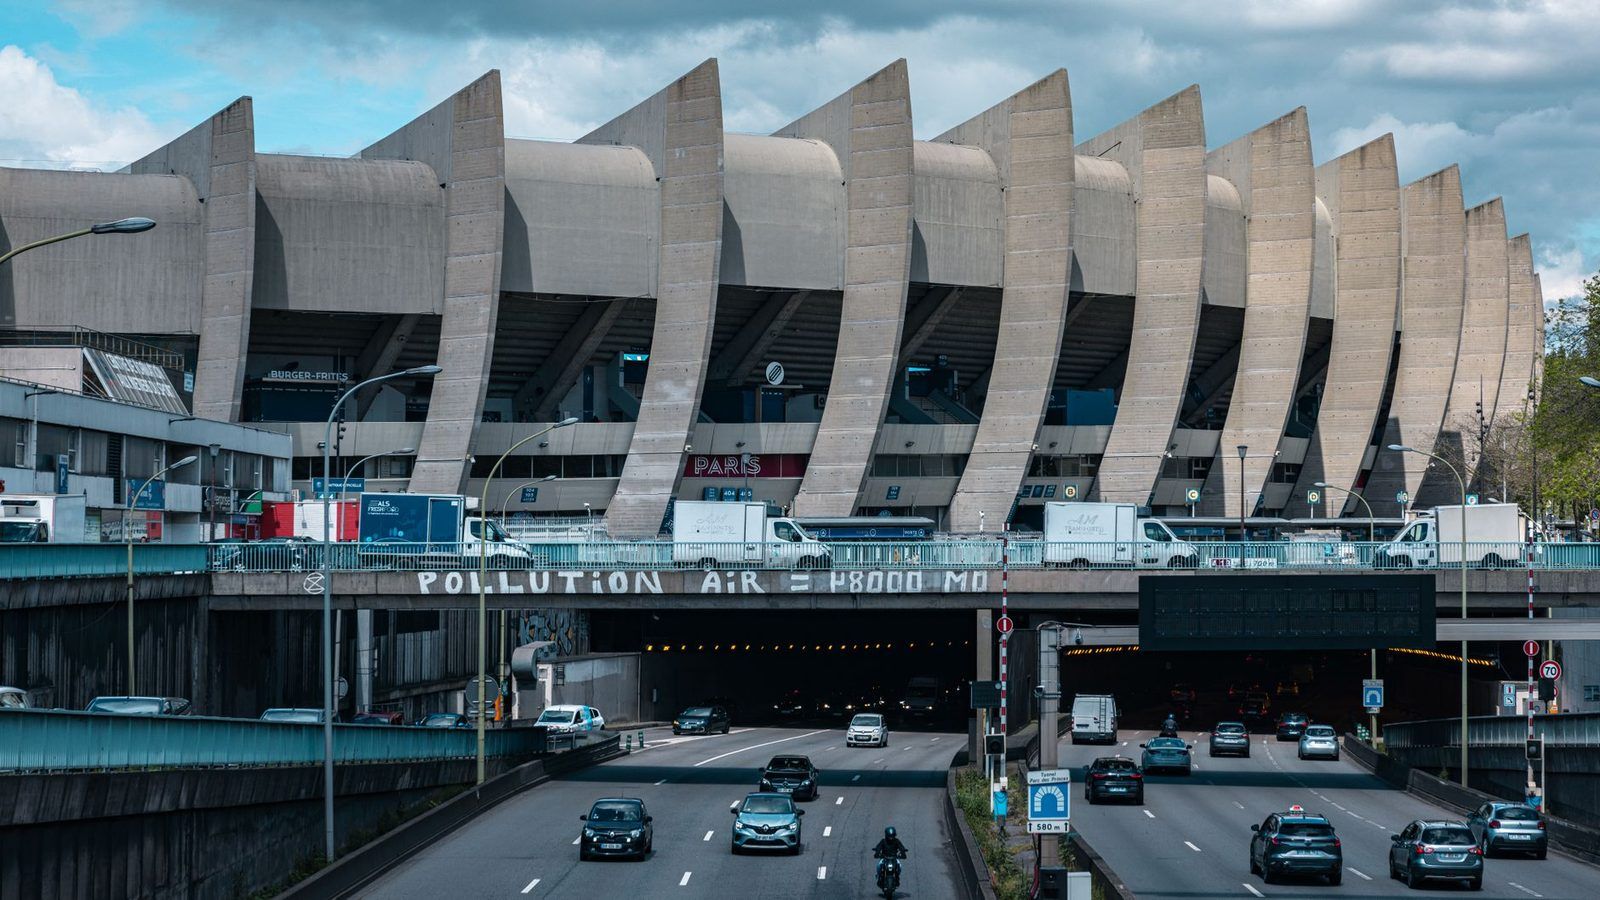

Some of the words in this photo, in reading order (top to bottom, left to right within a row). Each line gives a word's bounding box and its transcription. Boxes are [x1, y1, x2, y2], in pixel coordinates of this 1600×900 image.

[271, 370, 349, 382] BURGER-FRITES
[694, 456, 761, 475] PARIS
[1545, 666, 1557, 676] 70
[1036, 823, 1053, 831] 580
